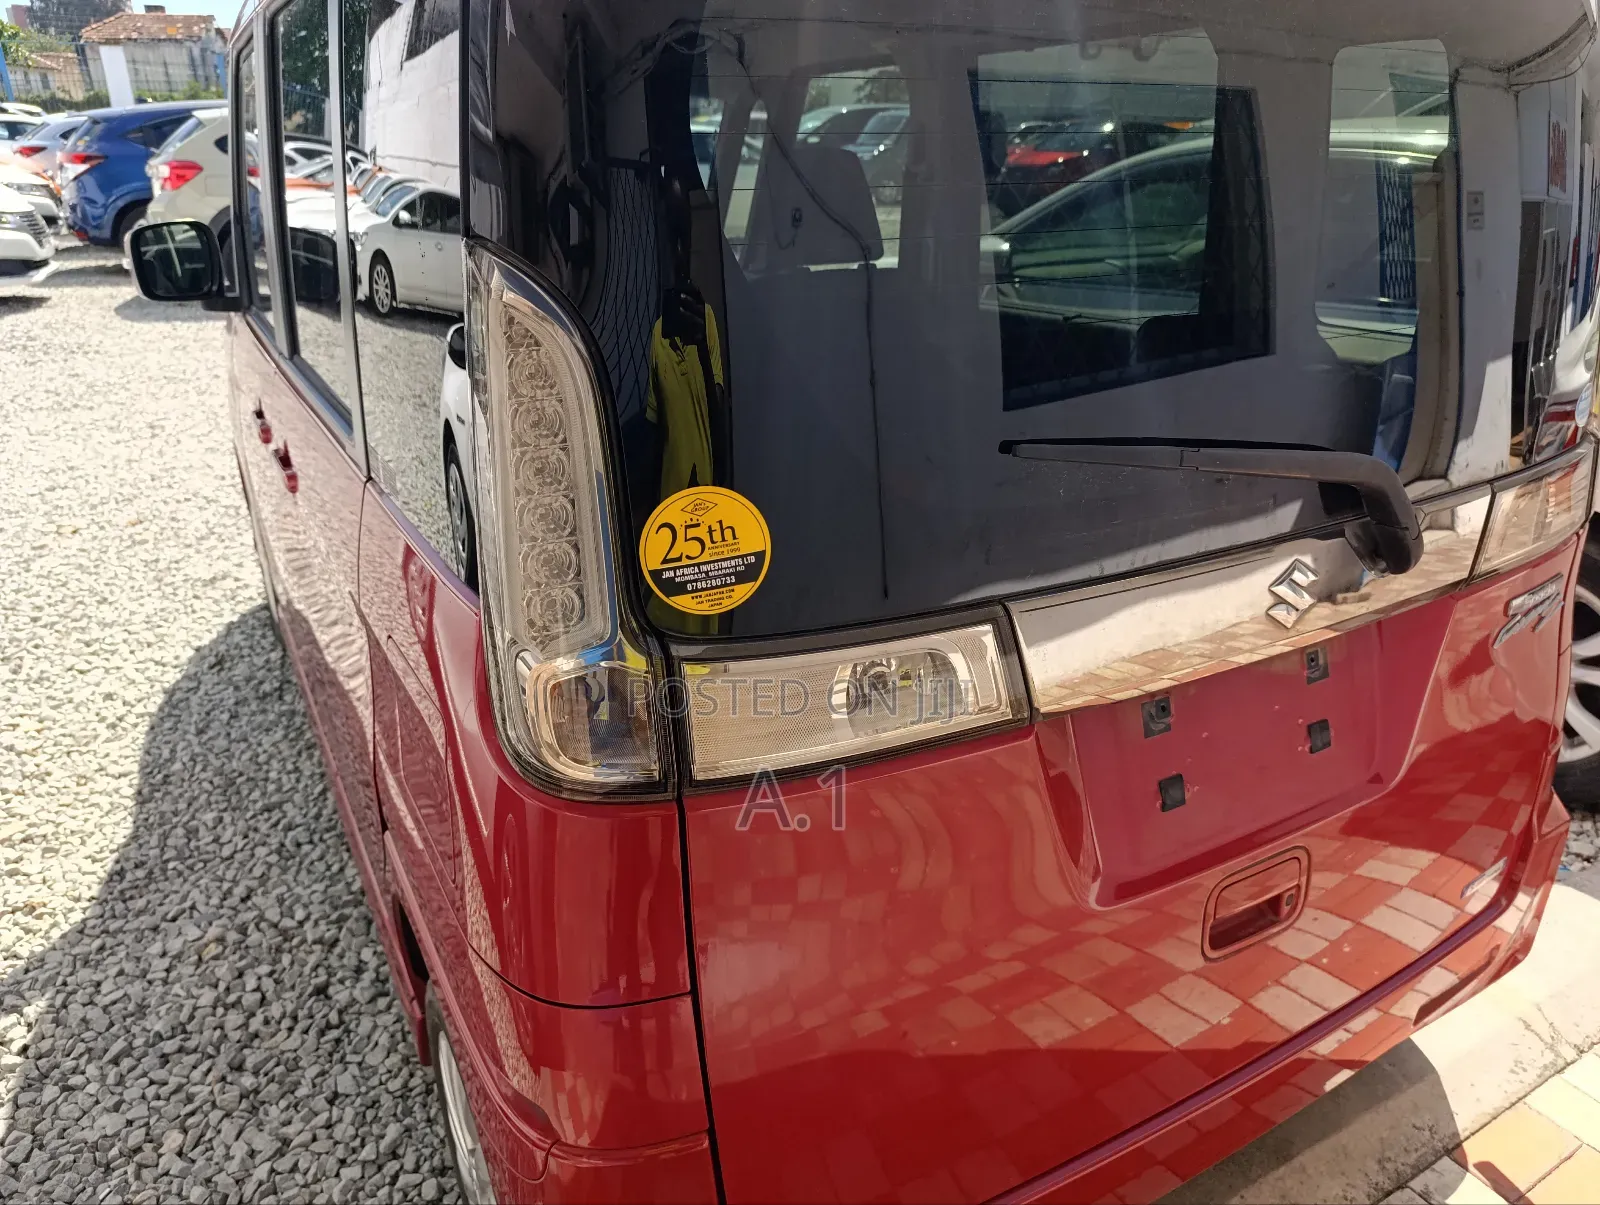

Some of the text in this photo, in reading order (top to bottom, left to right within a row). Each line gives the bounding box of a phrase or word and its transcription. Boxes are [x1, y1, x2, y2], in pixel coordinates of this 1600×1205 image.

[655, 519, 739, 565] 25th
[661, 555, 756, 579] JAN AFRICA INVESTMENTS LTD
[686, 575, 736, 591] 0786280733
